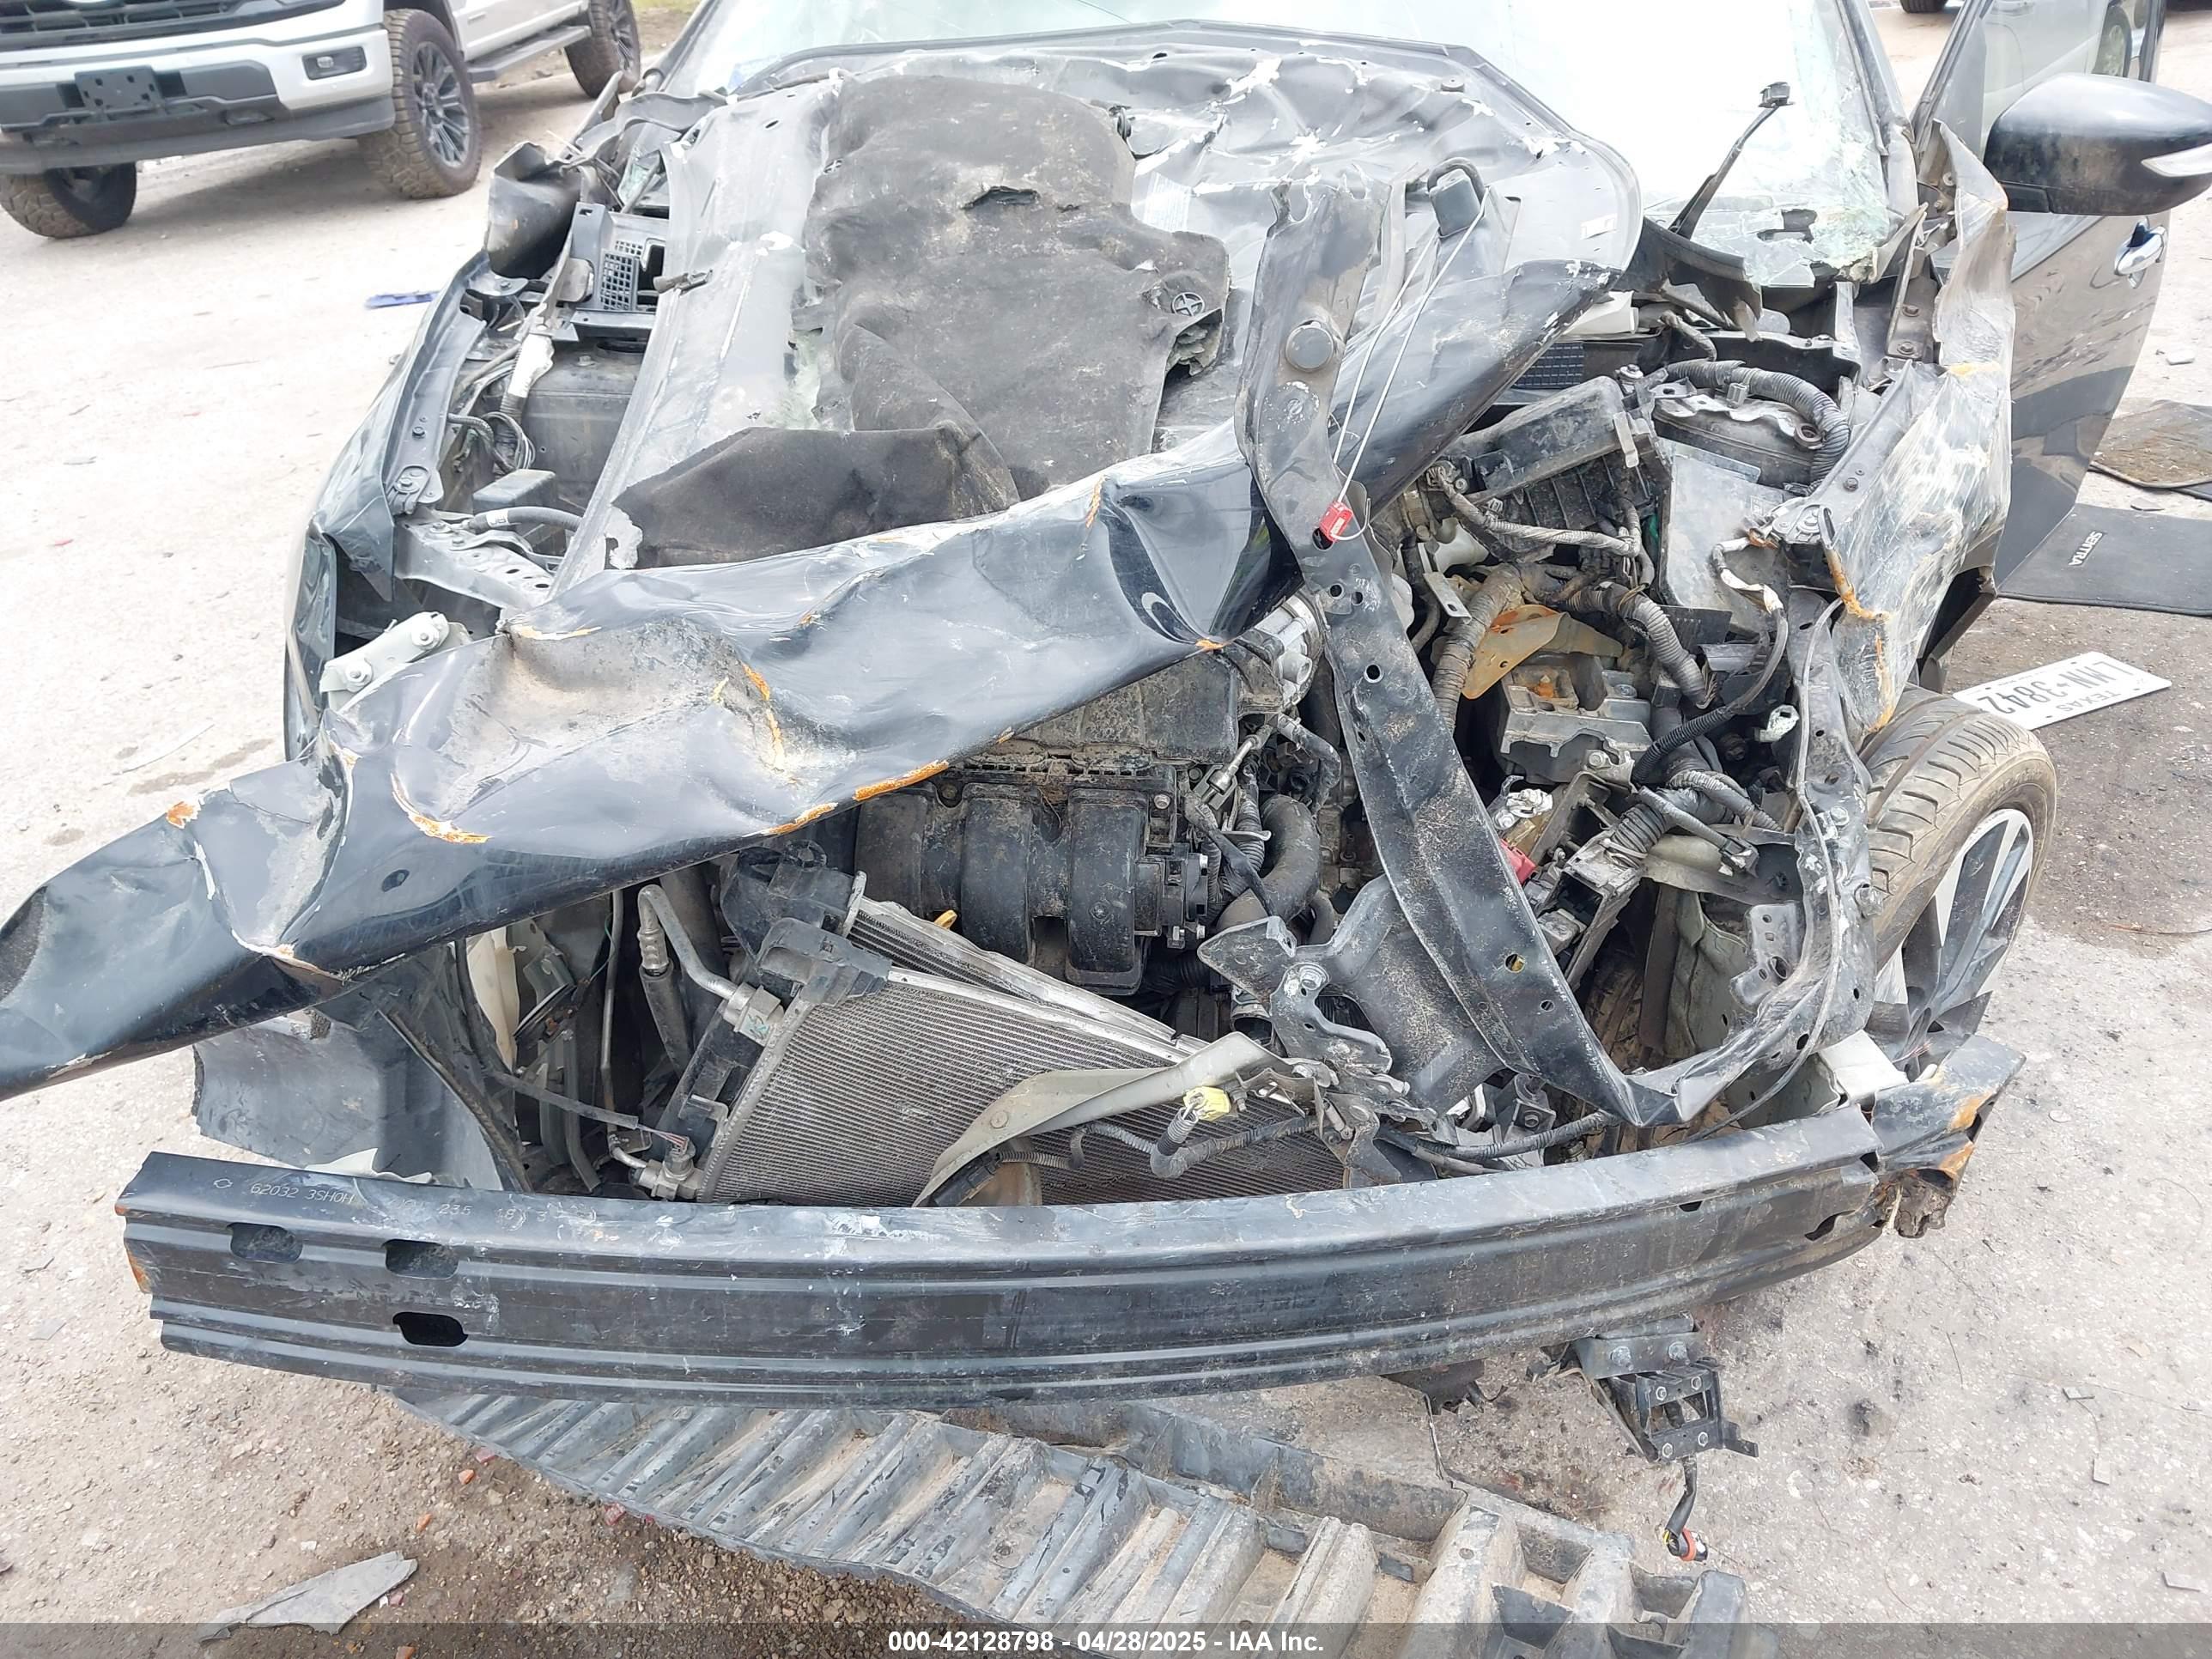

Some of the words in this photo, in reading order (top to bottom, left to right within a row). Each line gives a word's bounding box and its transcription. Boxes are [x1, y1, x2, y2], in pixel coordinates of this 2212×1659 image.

[2068, 531, 2103, 566] SENTRA
[2056, 690, 2122, 712] TEXAS
[250, 1182, 300, 1199] 62032
[438, 1203, 473, 1215] 235
